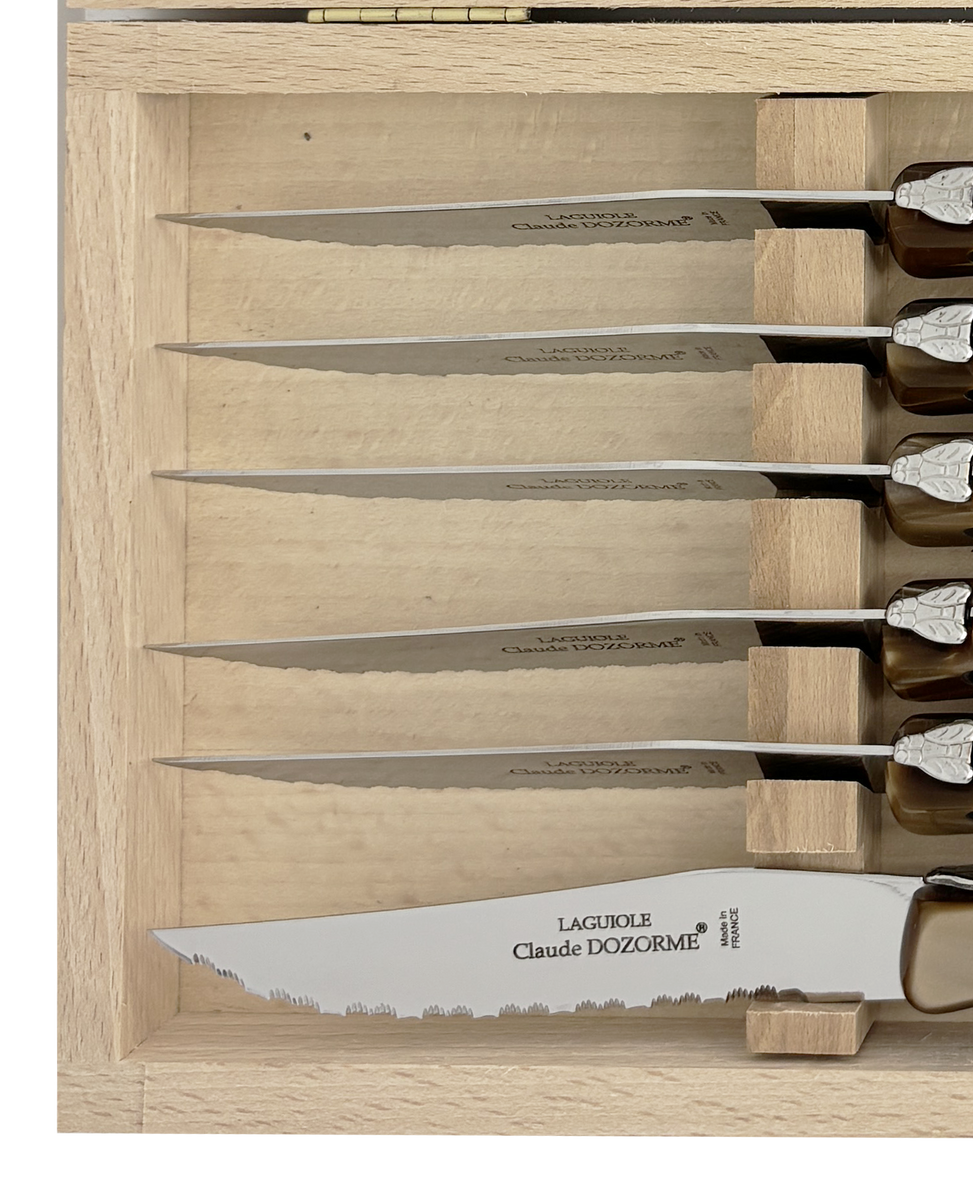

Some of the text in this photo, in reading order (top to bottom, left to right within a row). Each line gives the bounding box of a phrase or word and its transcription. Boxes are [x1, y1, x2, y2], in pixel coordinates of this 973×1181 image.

[545, 212, 638, 221] LAGUIOLE
[511, 222, 578, 231] Claude
[504, 355, 571, 363] Claude
[537, 634, 630, 644] LAGUIOLE
[501, 645, 569, 654] Claude
[557, 913, 652, 932] LAGUIOLE
[729, 907, 741, 949] FRANCE
[719, 923, 729, 947] Made
[512, 940, 582, 960] Claude
